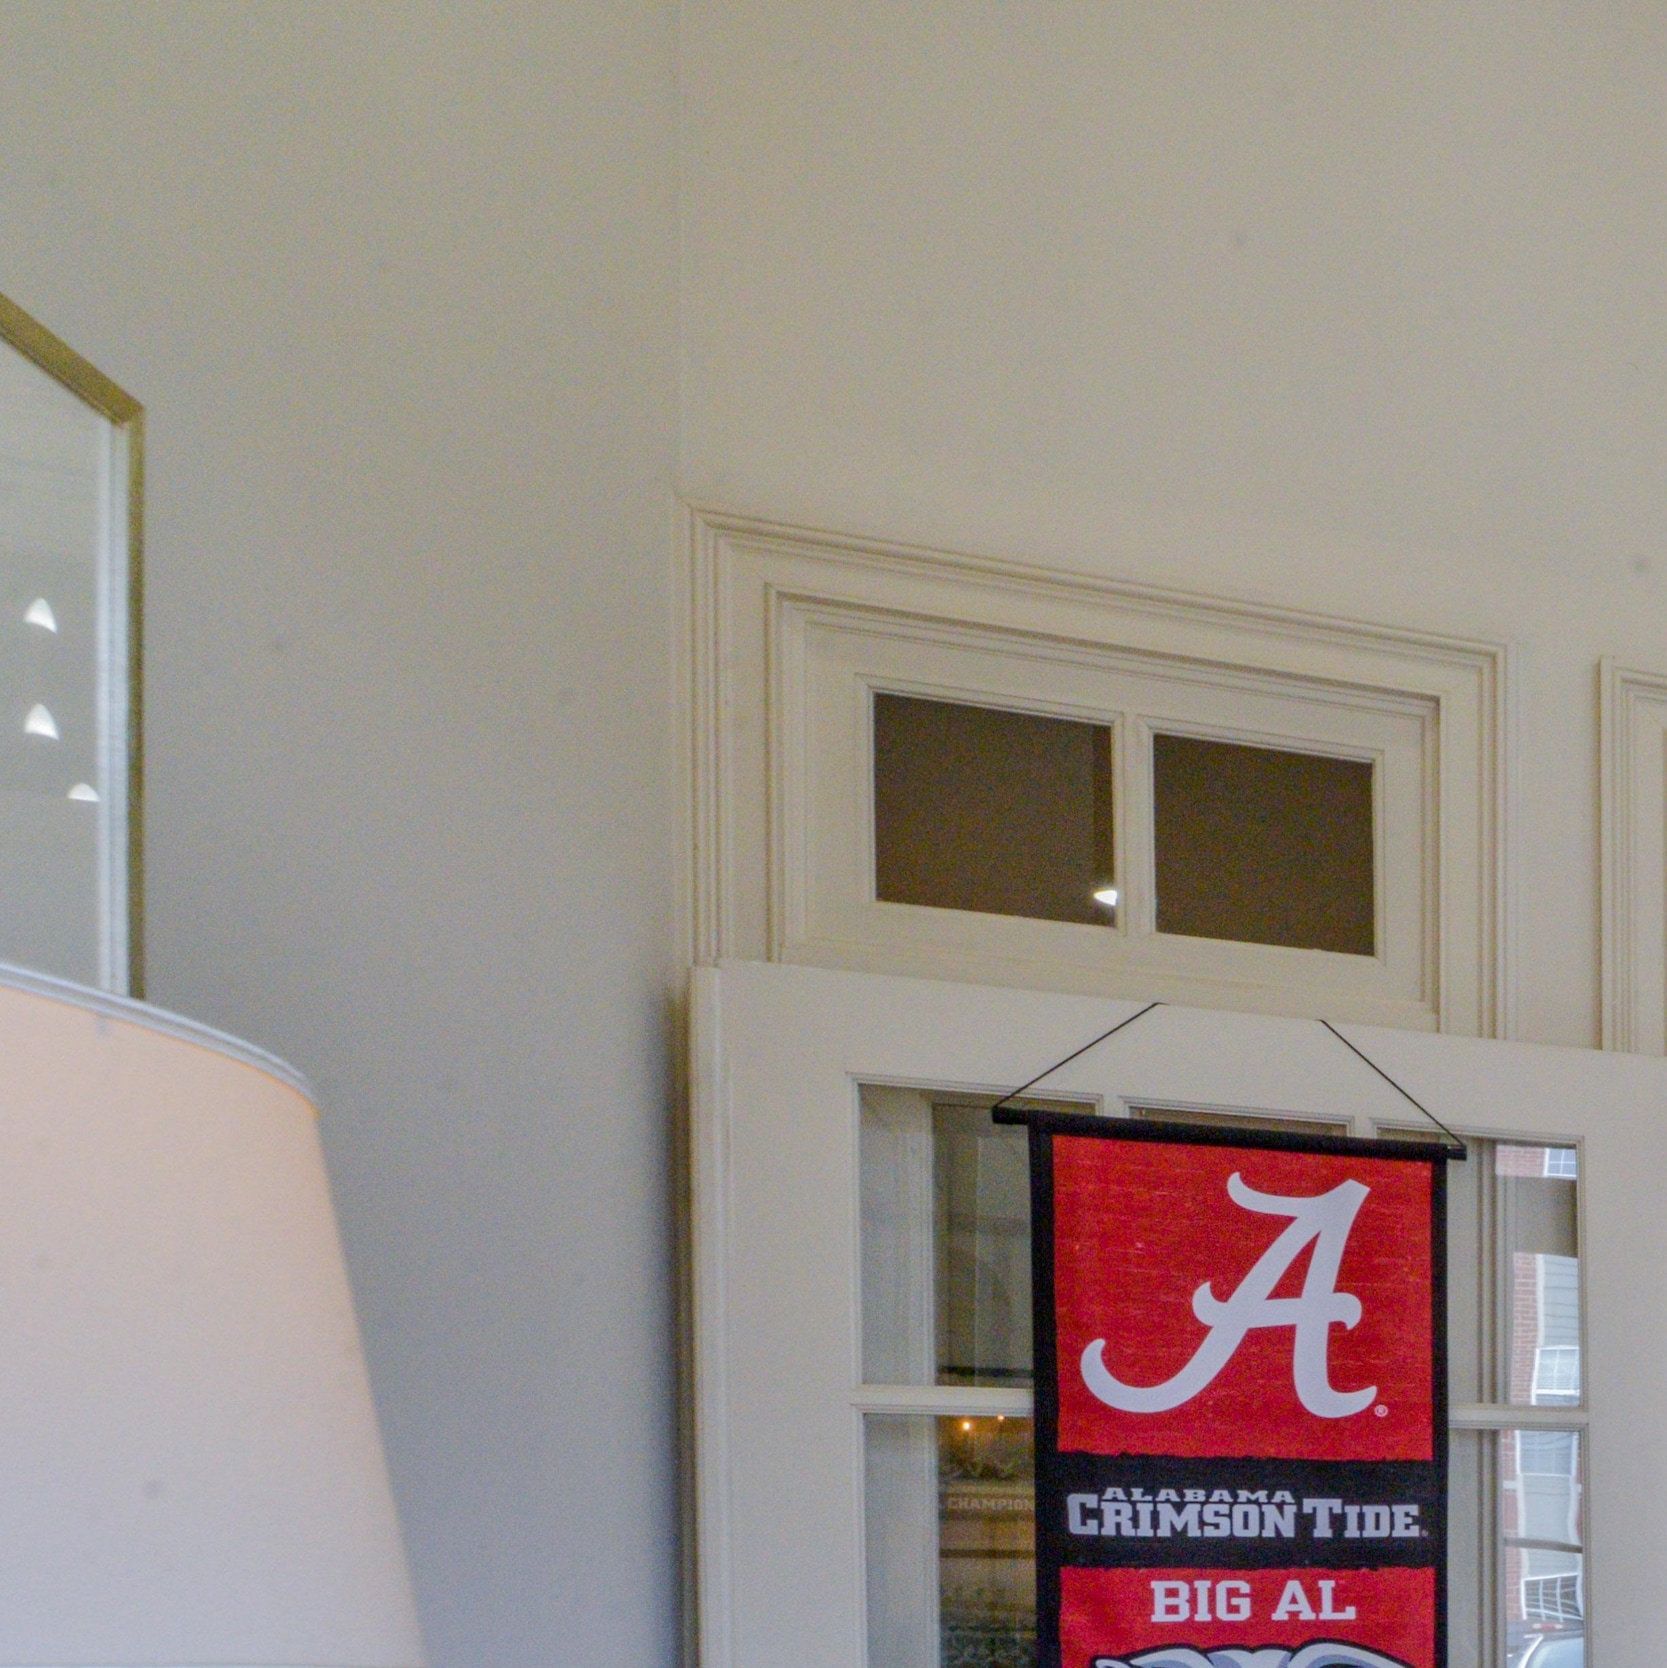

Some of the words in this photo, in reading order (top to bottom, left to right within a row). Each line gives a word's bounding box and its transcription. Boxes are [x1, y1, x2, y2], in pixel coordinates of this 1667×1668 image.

[1080, 1171, 1377, 1418] A
[1067, 1493, 1297, 1538] CRIMSON
[1303, 1499, 1420, 1538] TIDE
[1102, 1487, 1295, 1503] ALABAMA
[1150, 1580, 1251, 1623] BIG
[1271, 1580, 1356, 1621] AL
